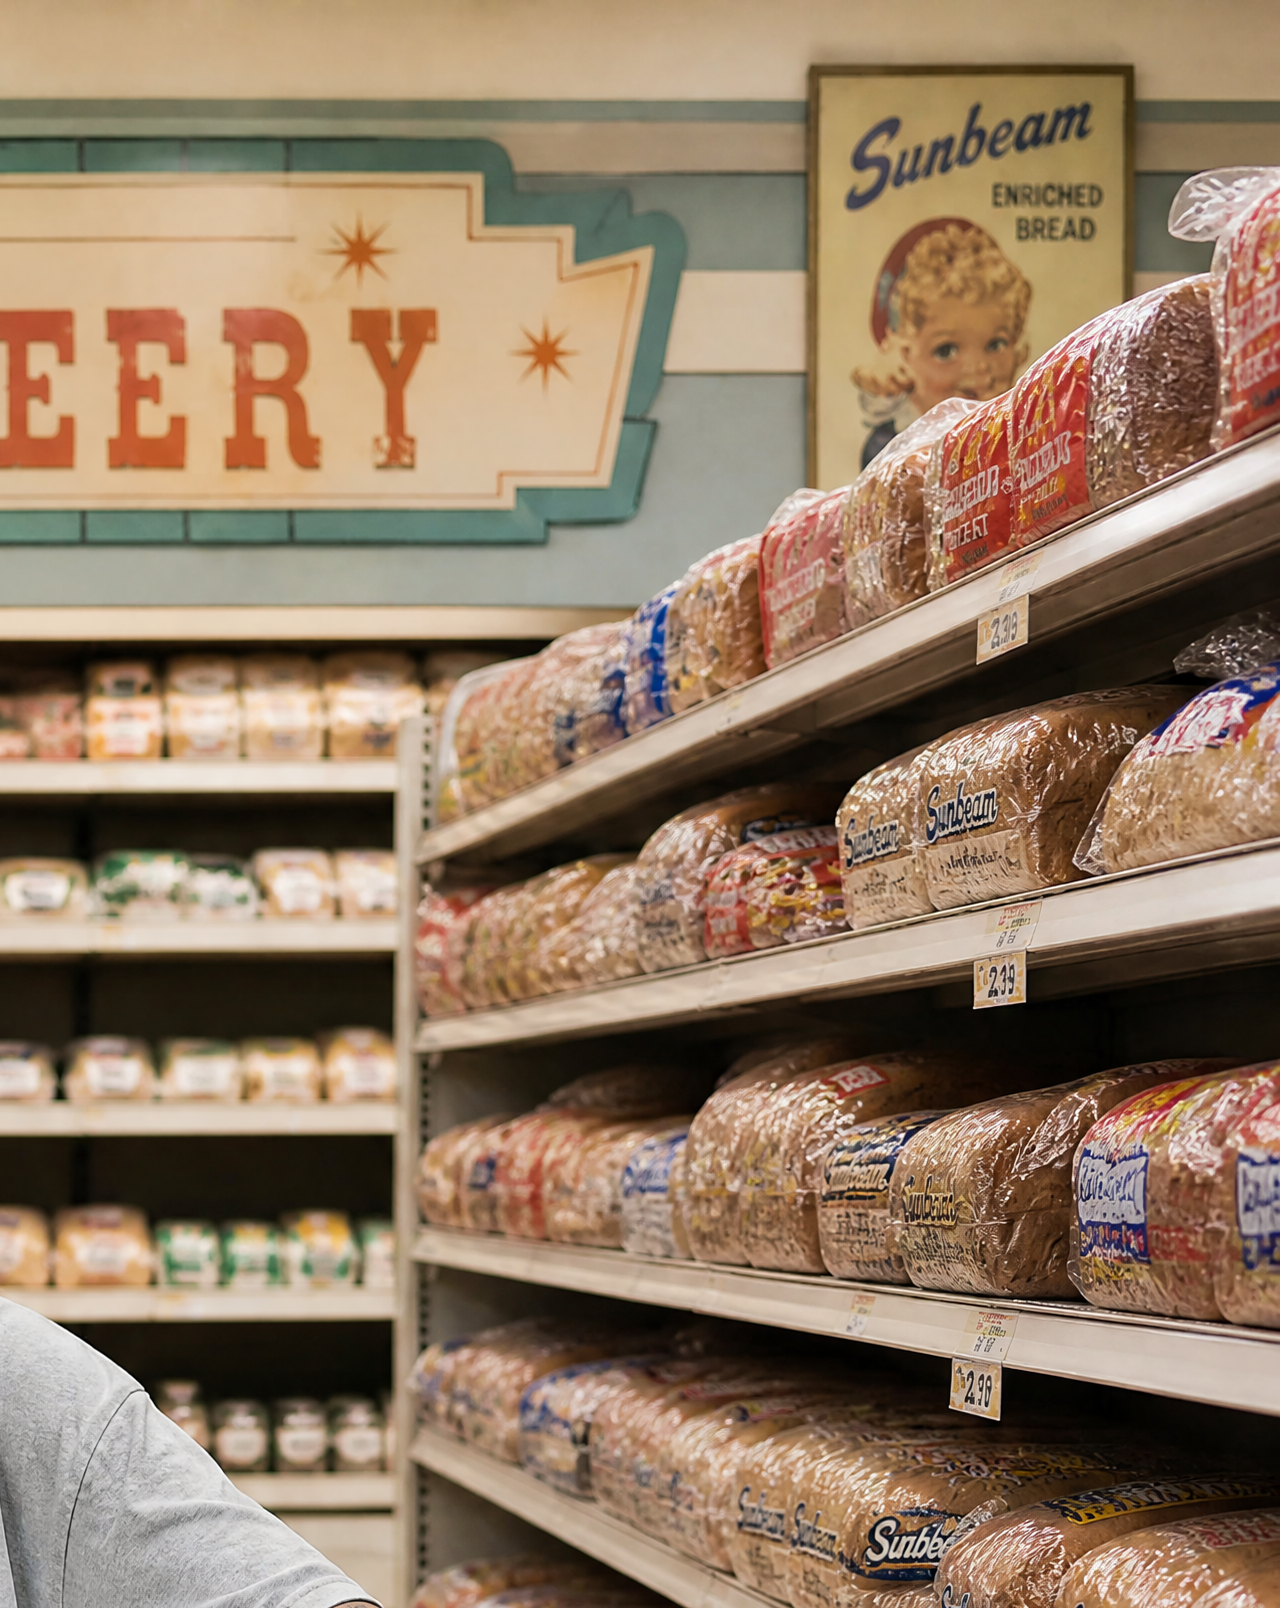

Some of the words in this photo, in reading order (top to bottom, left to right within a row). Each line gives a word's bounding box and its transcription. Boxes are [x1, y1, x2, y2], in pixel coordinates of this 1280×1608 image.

[845, 101, 1094, 211] Sunbeam
[991, 182, 1105, 209] ENRICHED
[1015, 215, 1097, 242] BREAD
